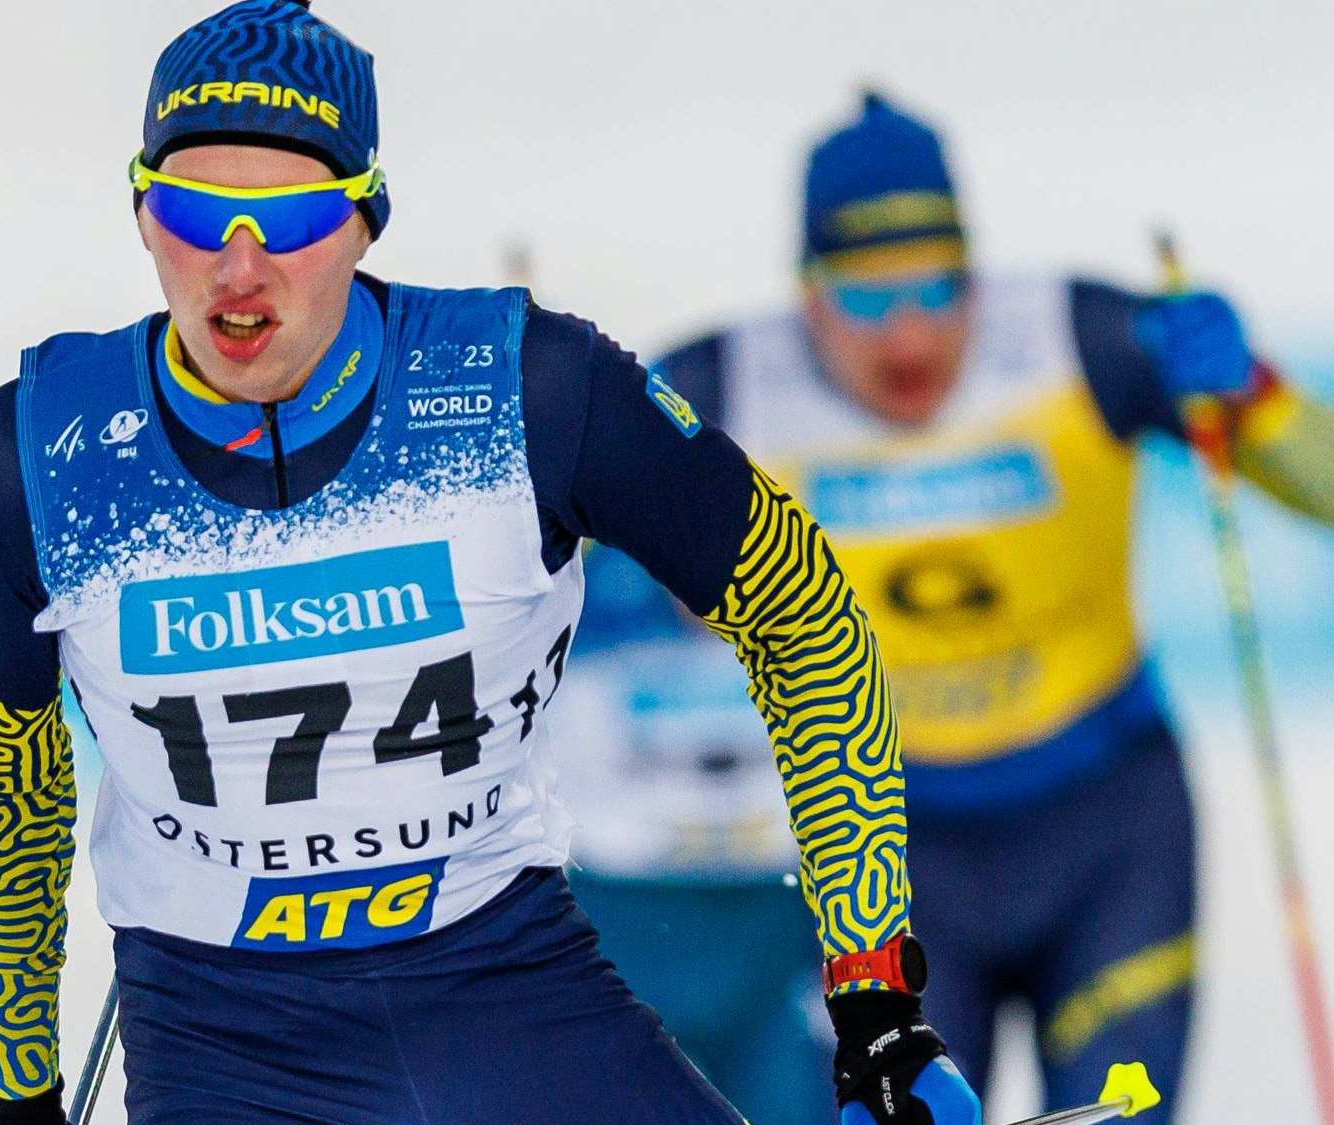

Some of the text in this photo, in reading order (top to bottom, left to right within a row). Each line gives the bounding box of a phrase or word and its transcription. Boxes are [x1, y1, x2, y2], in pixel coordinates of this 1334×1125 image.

[156, 81, 341, 129] UKRAINE
[407, 394, 493, 417] WORLD
[431, 384, 463, 393] NORDIC
[407, 416, 492, 430] CHAMPIONSHIPS
[116, 445, 138, 459] IBU
[150, 581, 432, 658] Folksam
[130, 650, 495, 808] 174
[243, 872, 434, 944] ATG
